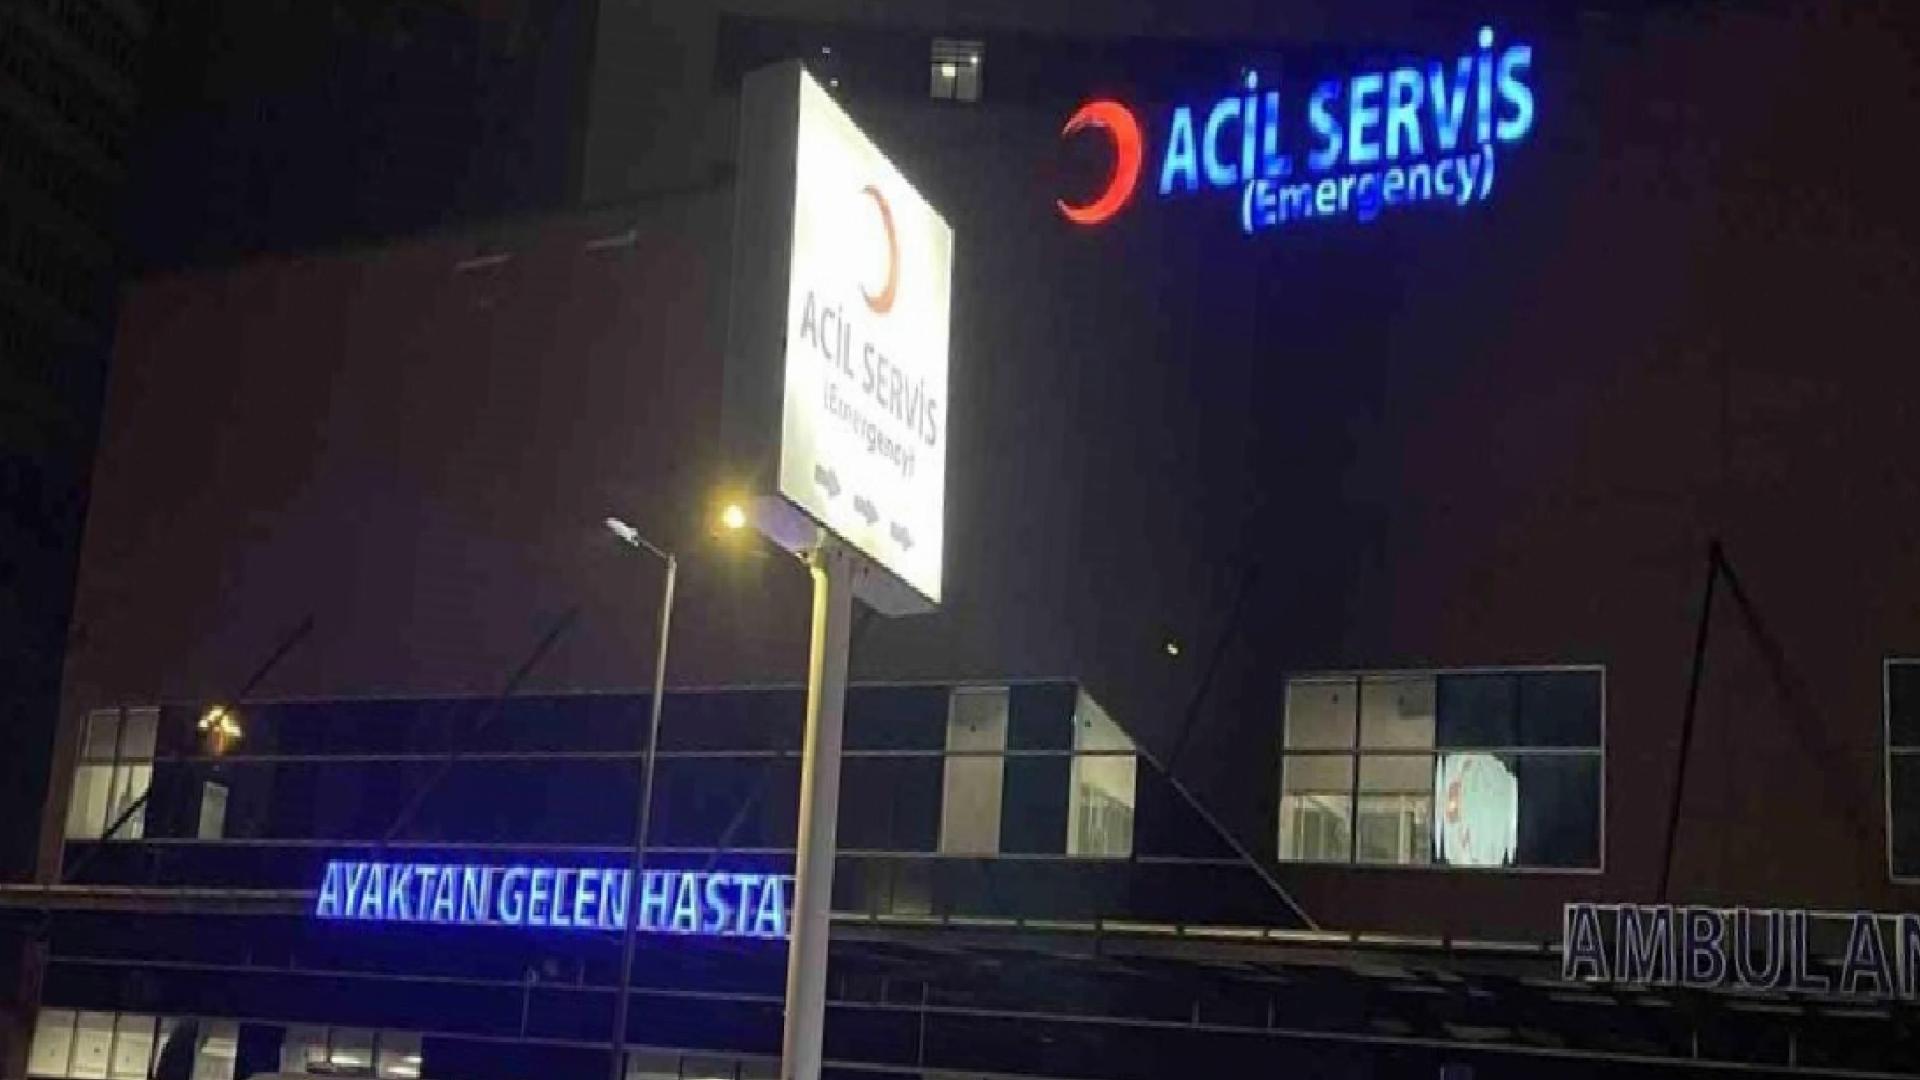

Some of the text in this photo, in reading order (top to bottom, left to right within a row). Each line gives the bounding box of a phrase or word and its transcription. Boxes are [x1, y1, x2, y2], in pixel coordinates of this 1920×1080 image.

[1160, 26, 1534, 195] ACİL SERVİS
[1242, 144, 1494, 234] (Emergency)
[800, 290, 855, 378] ACİL
[316, 861, 788, 938] AYAKTAN GELEN HASTA
